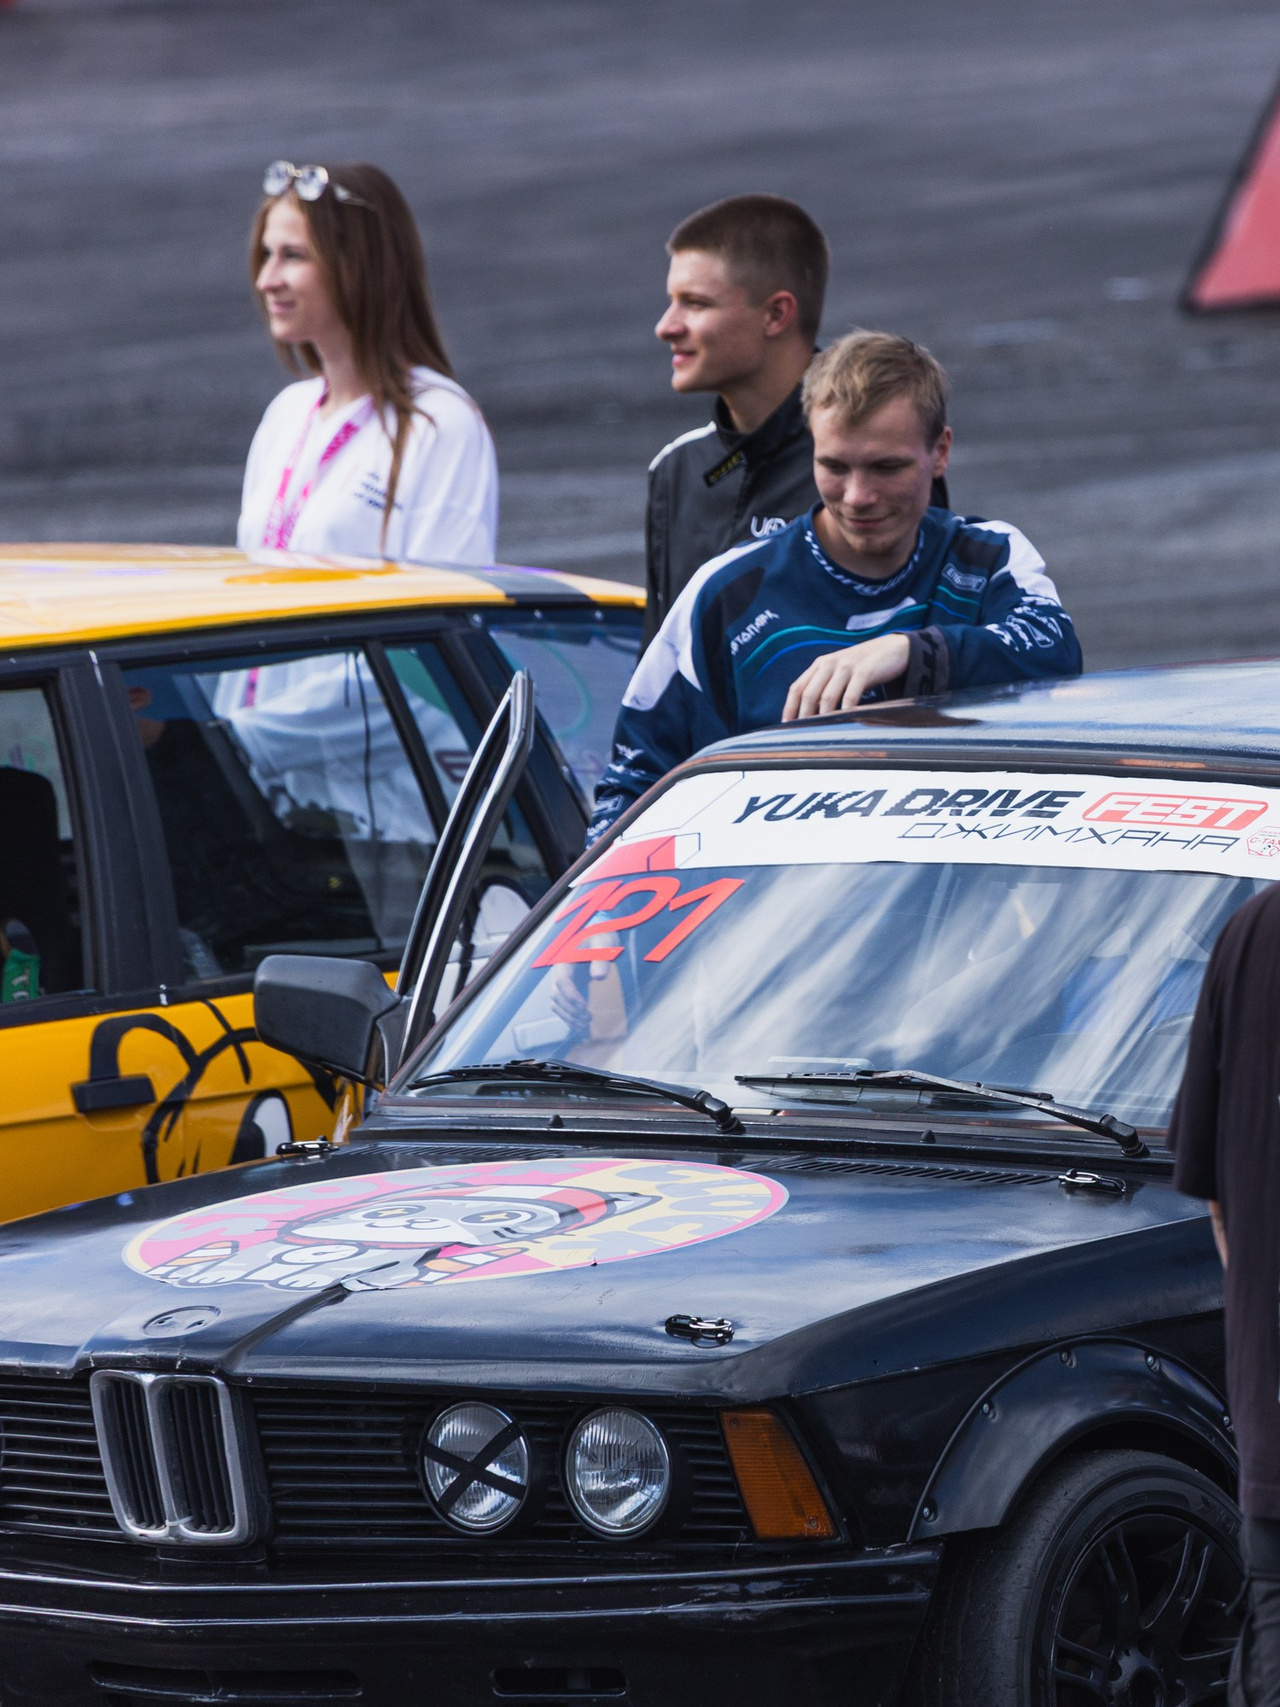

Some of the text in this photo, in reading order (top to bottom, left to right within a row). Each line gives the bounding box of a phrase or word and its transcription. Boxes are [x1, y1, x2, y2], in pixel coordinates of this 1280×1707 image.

[733, 788, 1264, 828] YUKA DRIVE FEST
[898, 822, 1240, 854] ДЖИМХАНА
[530, 876, 745, 969] 121
